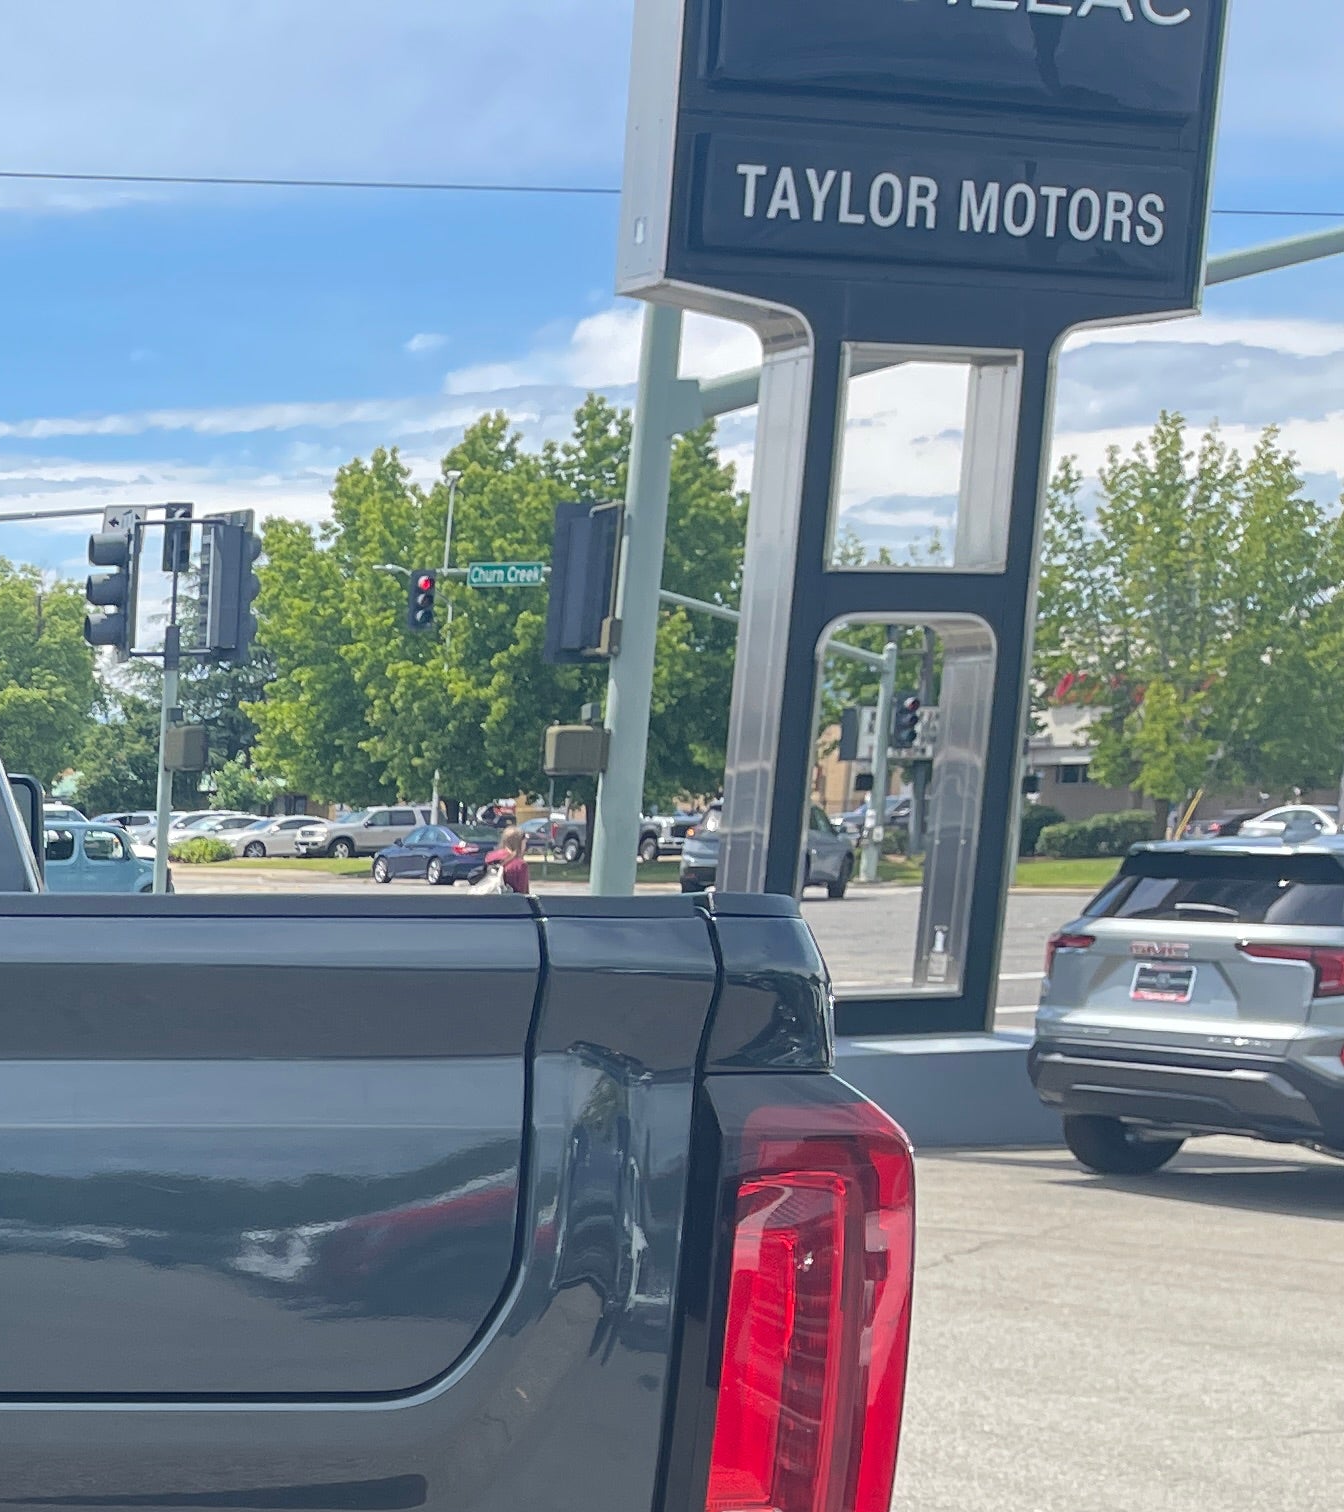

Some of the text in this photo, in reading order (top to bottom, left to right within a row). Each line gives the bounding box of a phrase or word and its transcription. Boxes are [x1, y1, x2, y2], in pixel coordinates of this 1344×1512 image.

[737, 163, 1165, 247] TAYLOR MOTORS
[507, 566, 539, 582] Creek
